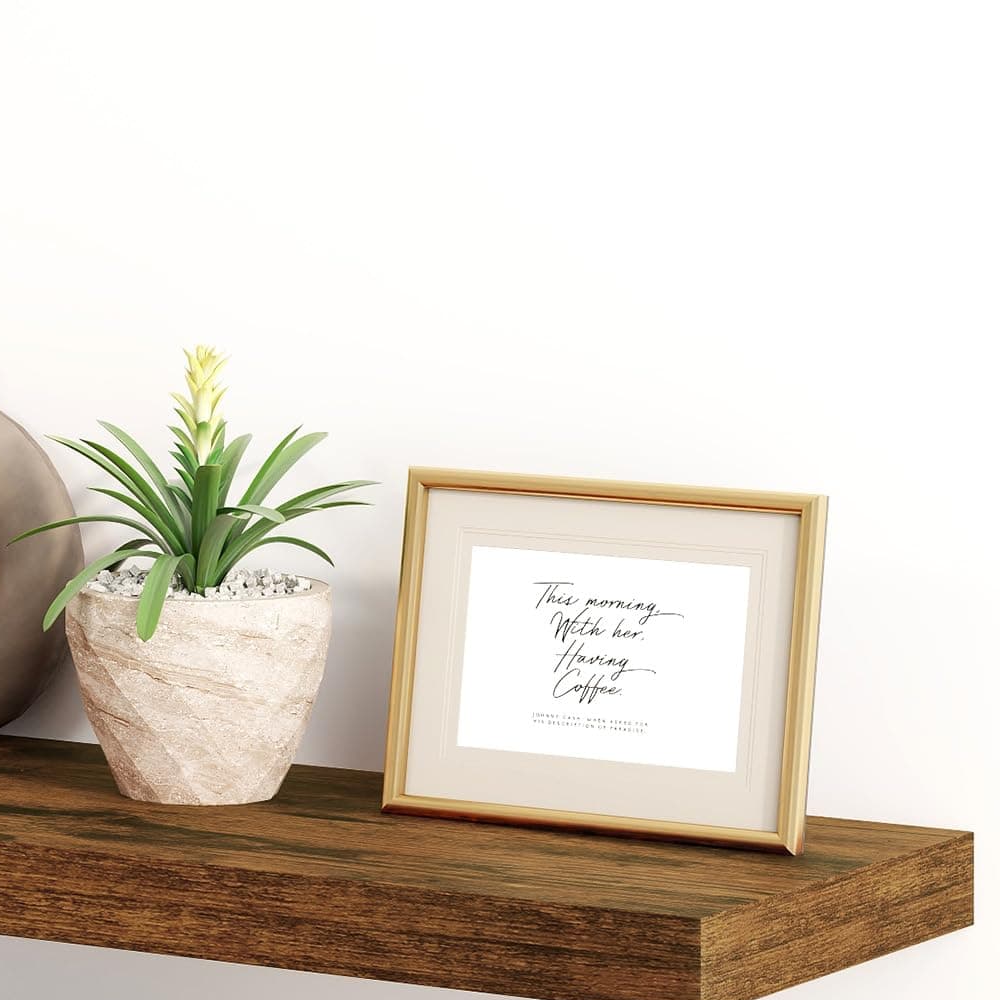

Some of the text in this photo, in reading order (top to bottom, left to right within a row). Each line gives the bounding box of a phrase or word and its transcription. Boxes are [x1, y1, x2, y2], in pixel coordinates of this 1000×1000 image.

[532, 581, 580, 609] This
[550, 607, 606, 643] With
[554, 640, 656, 682] Having
[552, 668, 623, 704] Coffee.
